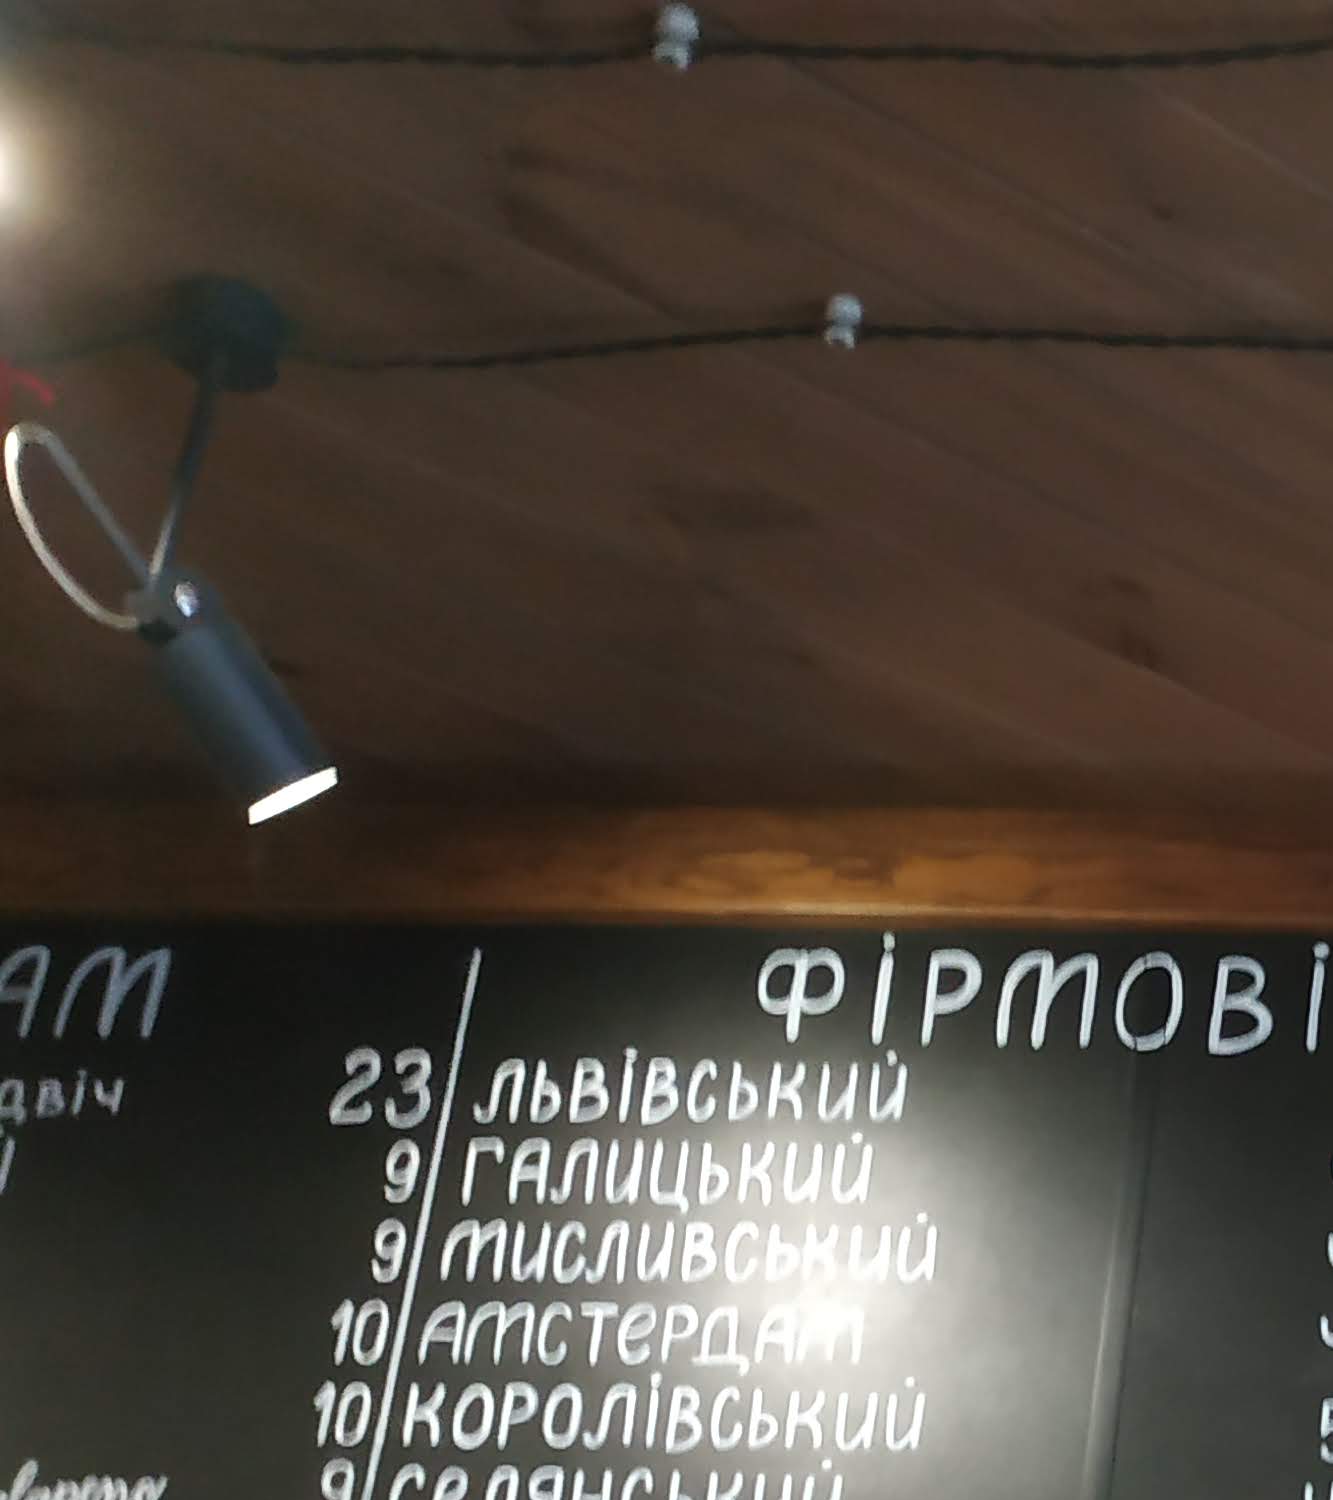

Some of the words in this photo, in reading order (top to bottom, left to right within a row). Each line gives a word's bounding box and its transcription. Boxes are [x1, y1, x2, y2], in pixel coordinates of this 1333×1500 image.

[757, 929, 1331, 1056] ФІРМОВІ
[330, 1047, 433, 1126] 23
[472, 1046, 908, 1125] ЛЬВІВСЬКИЙ
[383, 1138, 423, 1204] 9
[460, 1131, 875, 1214] ГАЛИЦЬКИЙ
[371, 1220, 408, 1282] 9
[439, 1212, 939, 1283] МИСЛИВСЬКИЙ
[330, 1299, 391, 1366] 10
[313, 1382, 372, 1449] 10
[400, 1372, 926, 1454] КОРОЛІВСЬКИЙ
